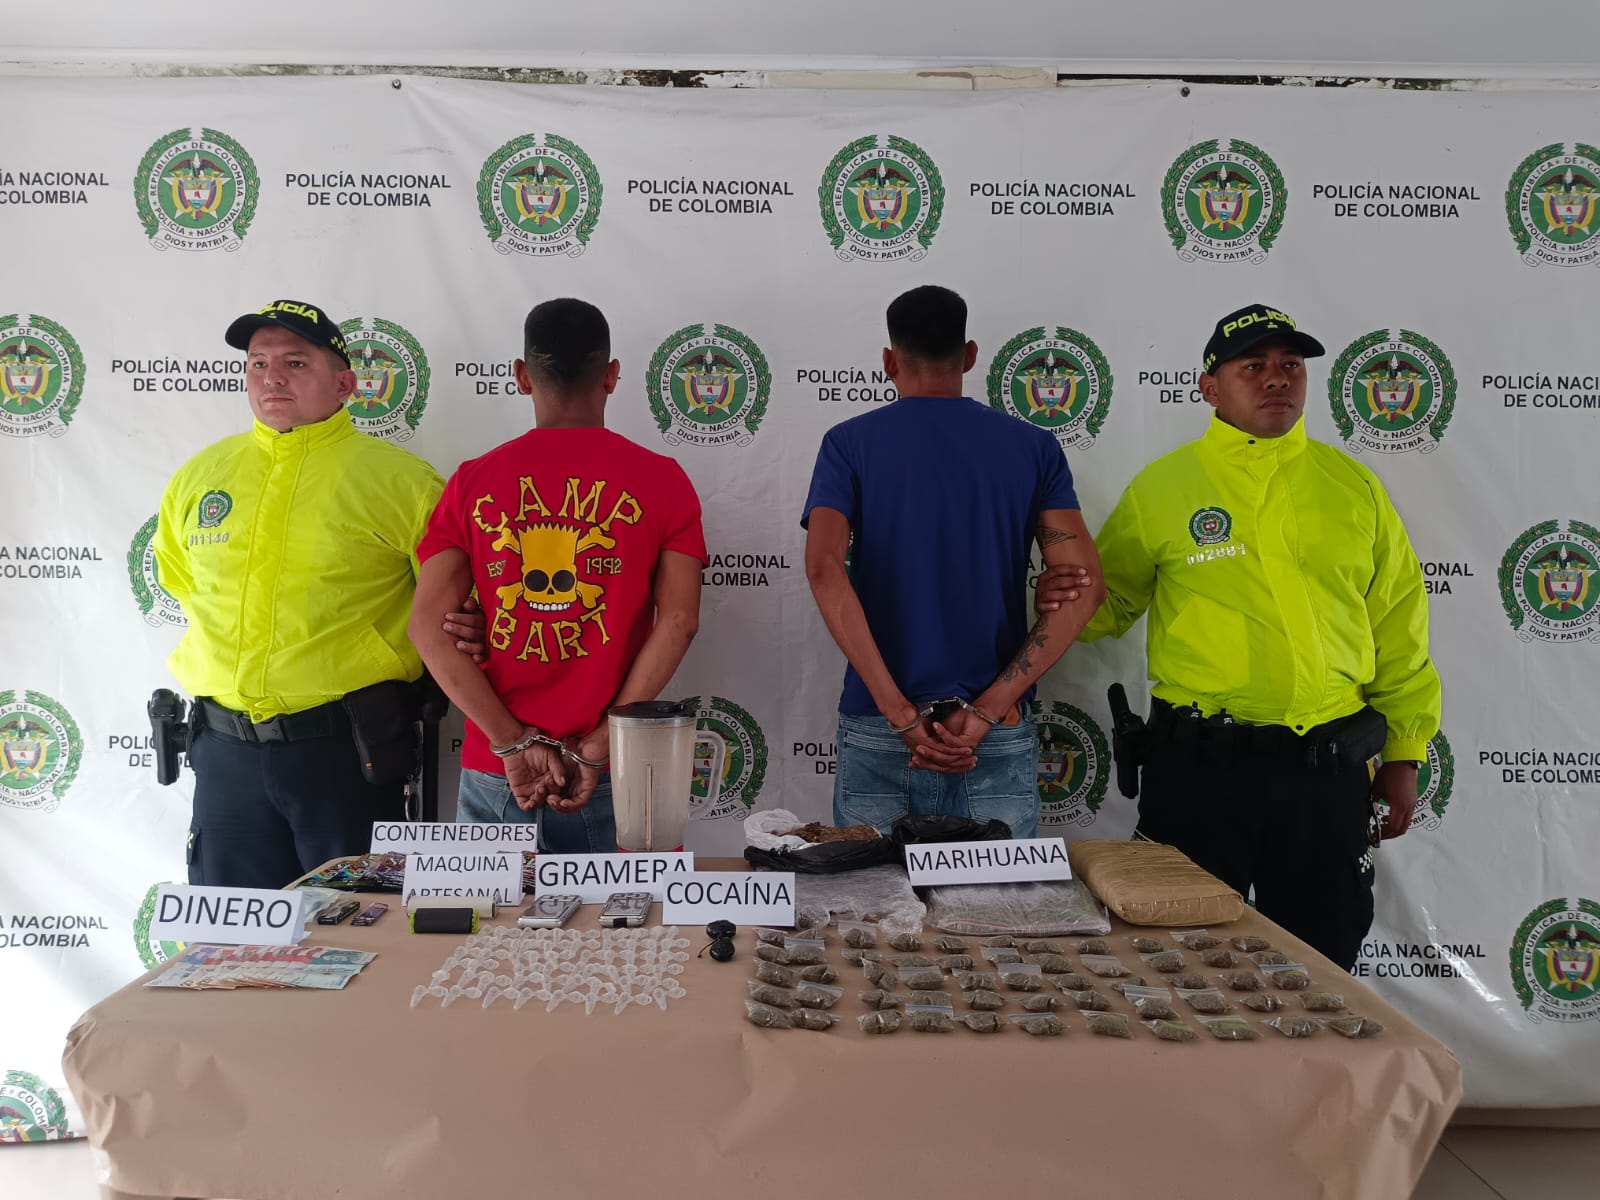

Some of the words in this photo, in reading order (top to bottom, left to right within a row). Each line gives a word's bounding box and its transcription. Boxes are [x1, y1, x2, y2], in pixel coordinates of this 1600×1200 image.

[19, 172, 109, 186] NACIONAL
[215, 148, 243, 196] COLOMBIA
[286, 170, 355, 188] POLICÍA
[361, 175, 451, 189] NACIONAL
[558, 155, 586, 203] COLOMBIA
[900, 156, 928, 206] COLOMBIA
[628, 176, 697, 195] POLICÍA
[703, 181, 793, 196] NACIONAL
[971, 179, 1039, 197] POLICÍA
[1045, 184, 1135, 198] NACIONAL
[1242, 159, 1270, 208] COLOMBIA
[1314, 181, 1383, 199] POLICÍA
[1389, 186, 1480, 201] NACIONAL
[308, 192, 330, 206] DE
[337, 191, 431, 207] COLOMBIA
[650, 199, 673, 213] DE
[679, 199, 773, 214] COLOMBIA
[992, 202, 1014, 215] DE
[1021, 202, 1115, 216] COLOMBIA
[1335, 204, 1357, 217] DE
[1364, 204, 1459, 218] COLOMBIA
[196, 207, 239, 236] NACIONAL
[540, 213, 582, 242] NACIONAL
[882, 217, 924, 247] NACIONAL
[1224, 219, 1266, 248] NACIONAL
[41, 334, 69, 382] COLOMBIA
[112, 357, 181, 374] POLICÍA
[387, 338, 415, 387] COLOMBIA
[727, 344, 755, 392] COLOMBIA
[456, 360, 515, 377] POLICÍ
[798, 367, 866, 384] POLICÍA
[1069, 346, 1097, 395] COLOMBIA
[1139, 368, 1199, 385] POLICÍ
[1412, 349, 1441, 398] COLOMBIA
[134, 378, 157, 392] DE
[476, 382, 499, 395] DE
[1483, 373, 1552, 390] POLICÍA
[819, 388, 841, 402] DE
[1160, 390, 1183, 403] DE
[1504, 394, 1527, 408] DE
[23, 393, 65, 422] NACIONAL
[368, 395, 411, 426] NACIONAL
[709, 403, 751, 431] NACIONAL
[1392, 409, 1435, 438] NACIONAL
[472, 476, 643, 533] CAMP
[16, 547, 102, 561] NACIONAL
[0, 565, 82, 579] OLOMBIA
[585, 557, 623, 575] 1992
[702, 573, 769, 587] LOMBIA
[489, 602, 611, 662] BART
[39, 710, 67, 758] COLOMBIA
[724, 716, 752, 765] COLOMBIA
[1066, 720, 1095, 771] COLOMBIA
[129, 753, 152, 768] DE
[1479, 749, 1548, 766] POLICÍA
[816, 761, 837, 775] DE
[1503, 769, 1525, 783] DE
[19, 768, 62, 797] NACIONAL
[717, 776, 749, 803] CIONAL
[1050, 781, 1092, 811] NACIONAL
[709, 803, 737, 817] ATRIA
[374, 824, 536, 842] CONTENEDORES
[416, 855, 509, 873] MAQUINA
[909, 843, 1067, 872] MARIHUANA
[538, 858, 688, 887] GRAMERA
[667, 876, 791, 905] COCAÍNA
[158, 893, 292, 928] DINERO
[11, 915, 108, 930] NACIONAL
[0, 933, 90, 948] OLOMBIA
